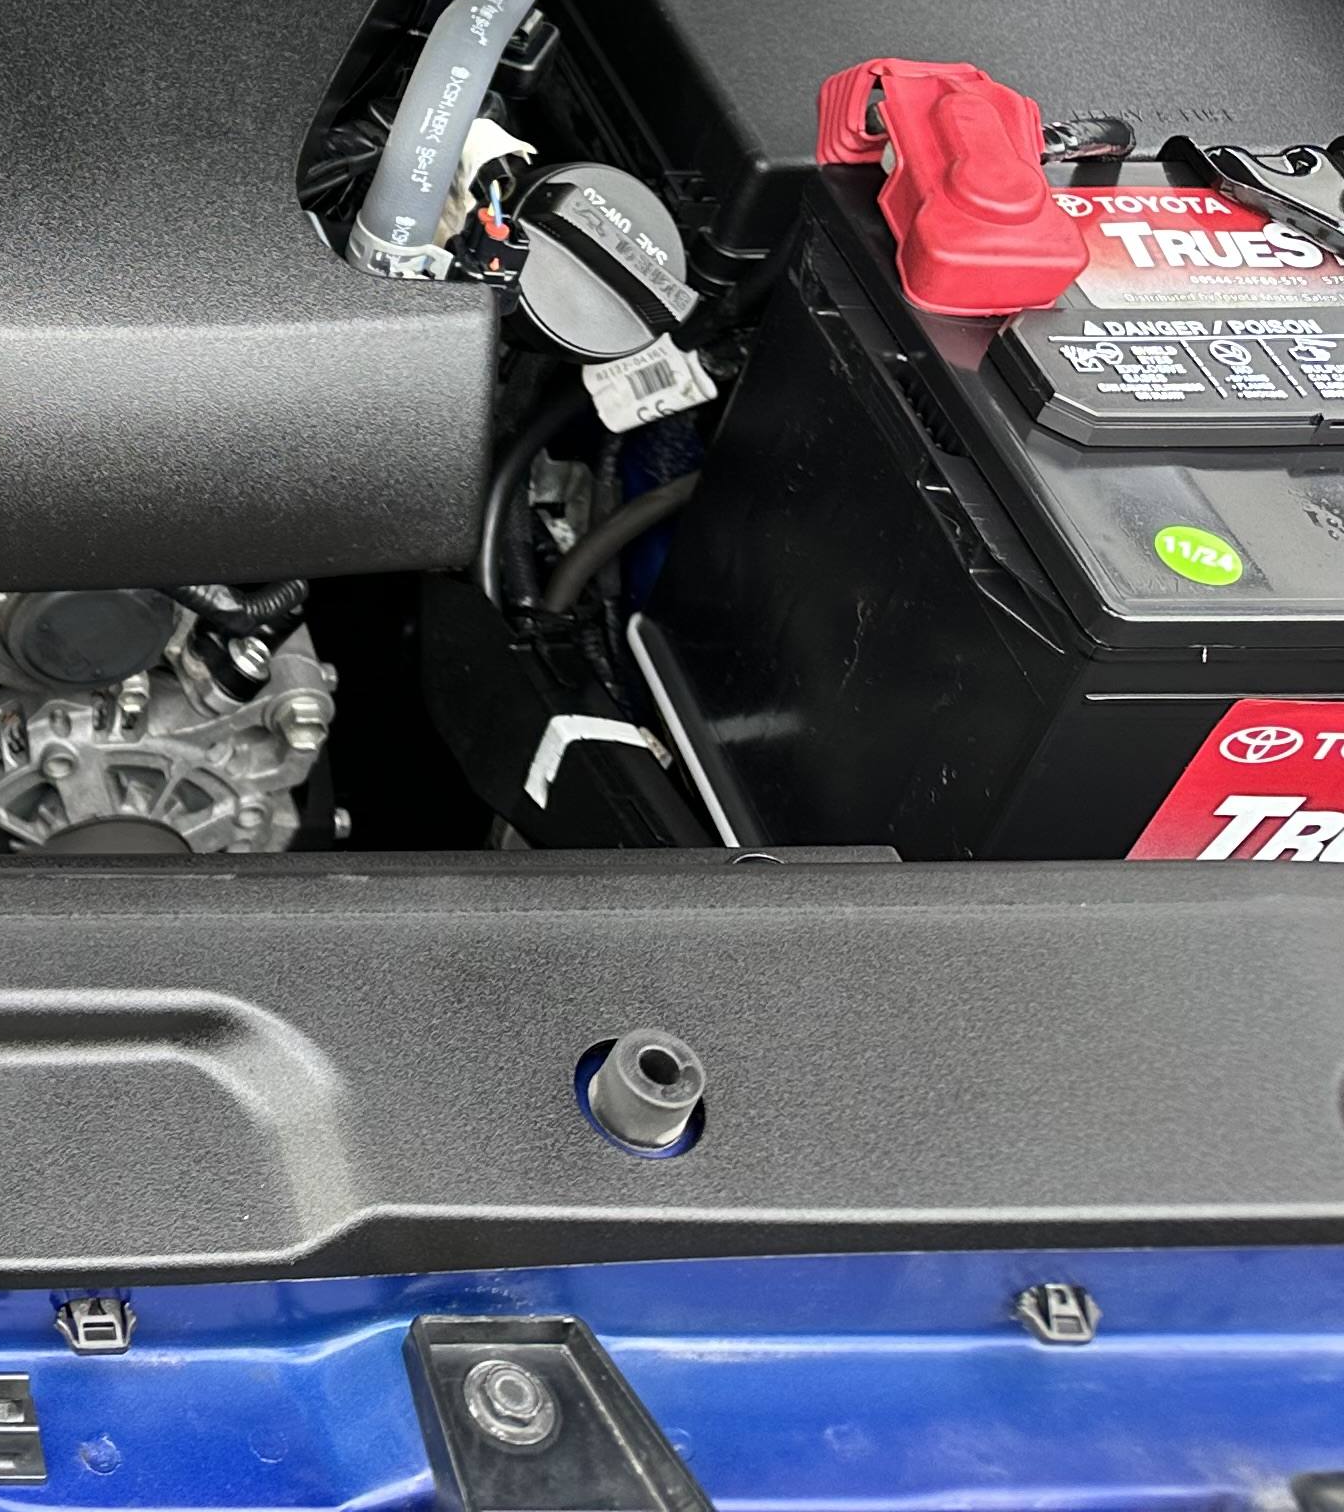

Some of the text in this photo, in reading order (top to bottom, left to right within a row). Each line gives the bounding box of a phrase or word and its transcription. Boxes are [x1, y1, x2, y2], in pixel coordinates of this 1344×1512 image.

[1092, 196, 1232, 215] TOYOTA
[1099, 220, 1344, 269] TRUES
[1102, 320, 1210, 337] DANGER
[1226, 318, 1324, 336] POISON
[1163, 535, 1233, 573] 11/24
